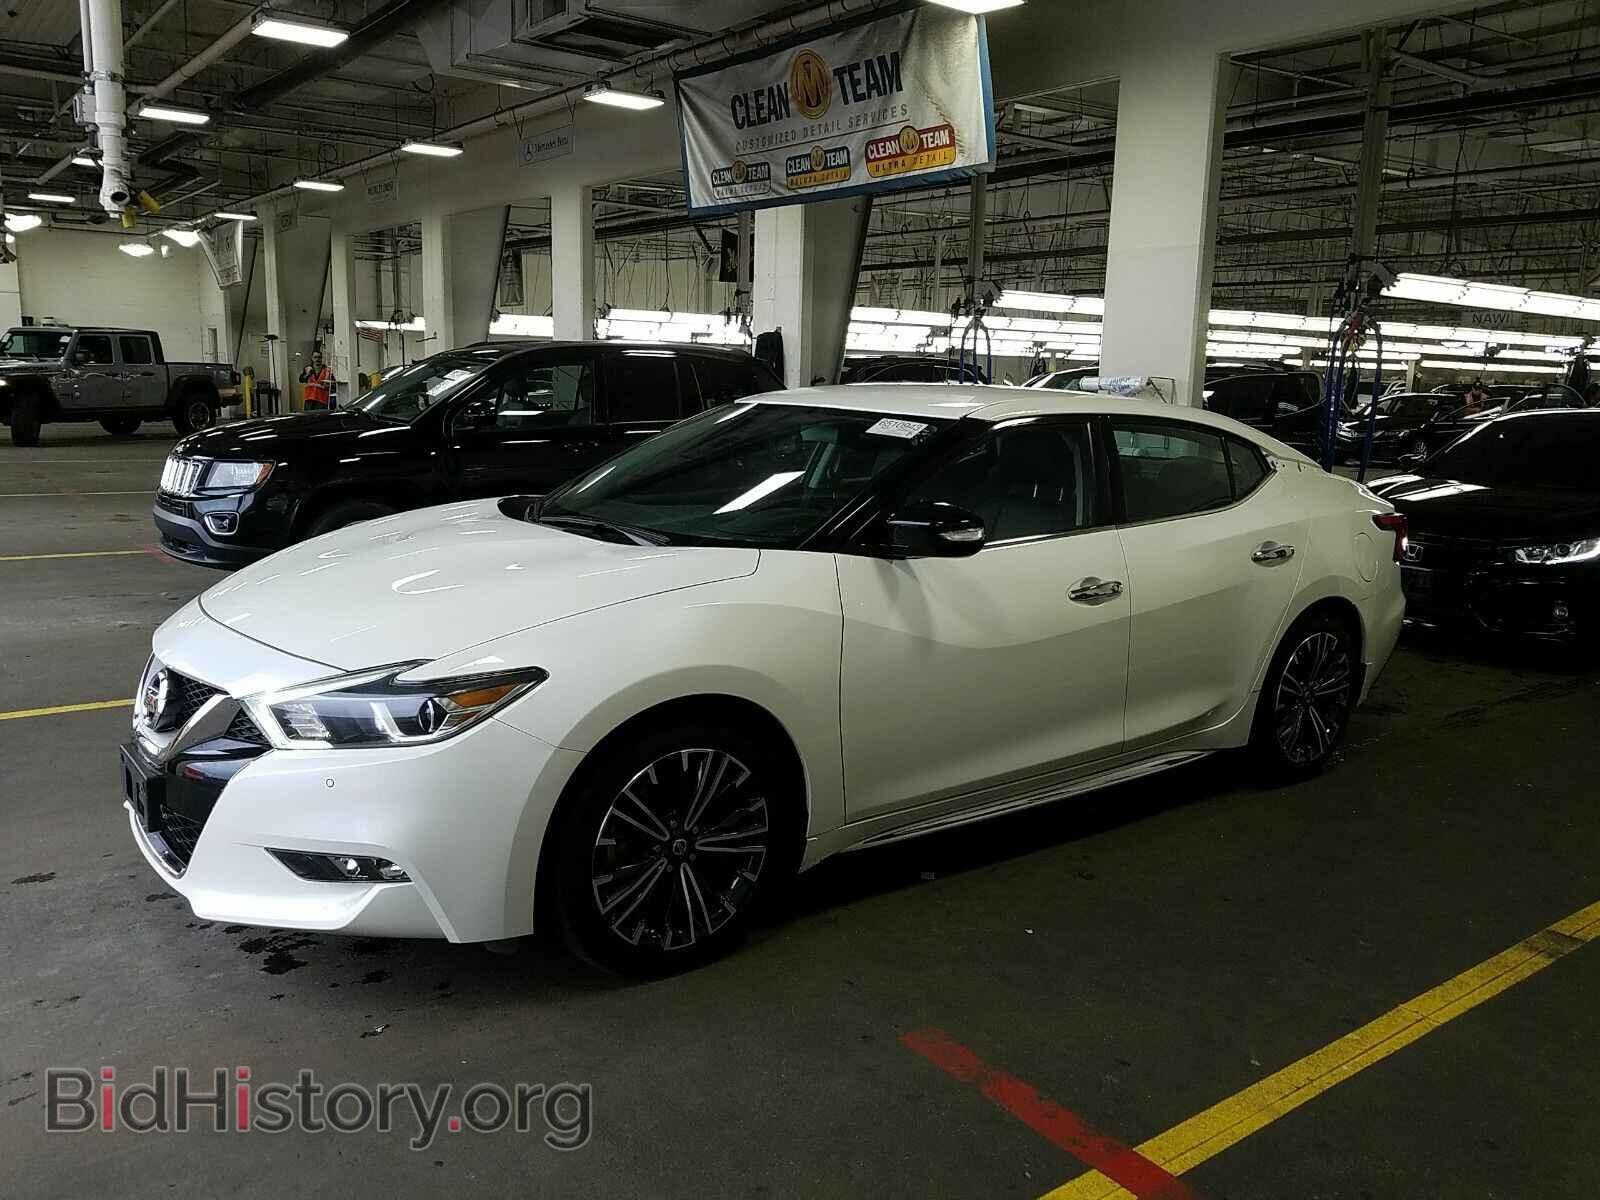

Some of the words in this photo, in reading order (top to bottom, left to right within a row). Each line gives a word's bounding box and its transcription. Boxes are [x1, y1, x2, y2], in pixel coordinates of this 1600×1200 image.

[731, 82, 790, 130] CLEAN
[833, 52, 903, 106] TEAM
[736, 129, 797, 152] CUSTOMIZED
[803, 119, 842, 138] DETAIL
[848, 103, 908, 128] SERVICES
[867, 139, 900, 159] CLEAN
[920, 129, 950, 148] TEAM
[787, 153, 811, 173] CLEAN
[826, 149, 848, 167] TEAM
[875, 159, 906, 172] ULTRA
[913, 151, 949, 165] DETAIL
[712, 169, 732, 185] CLEAN
[748, 165, 769, 180] TEAM
